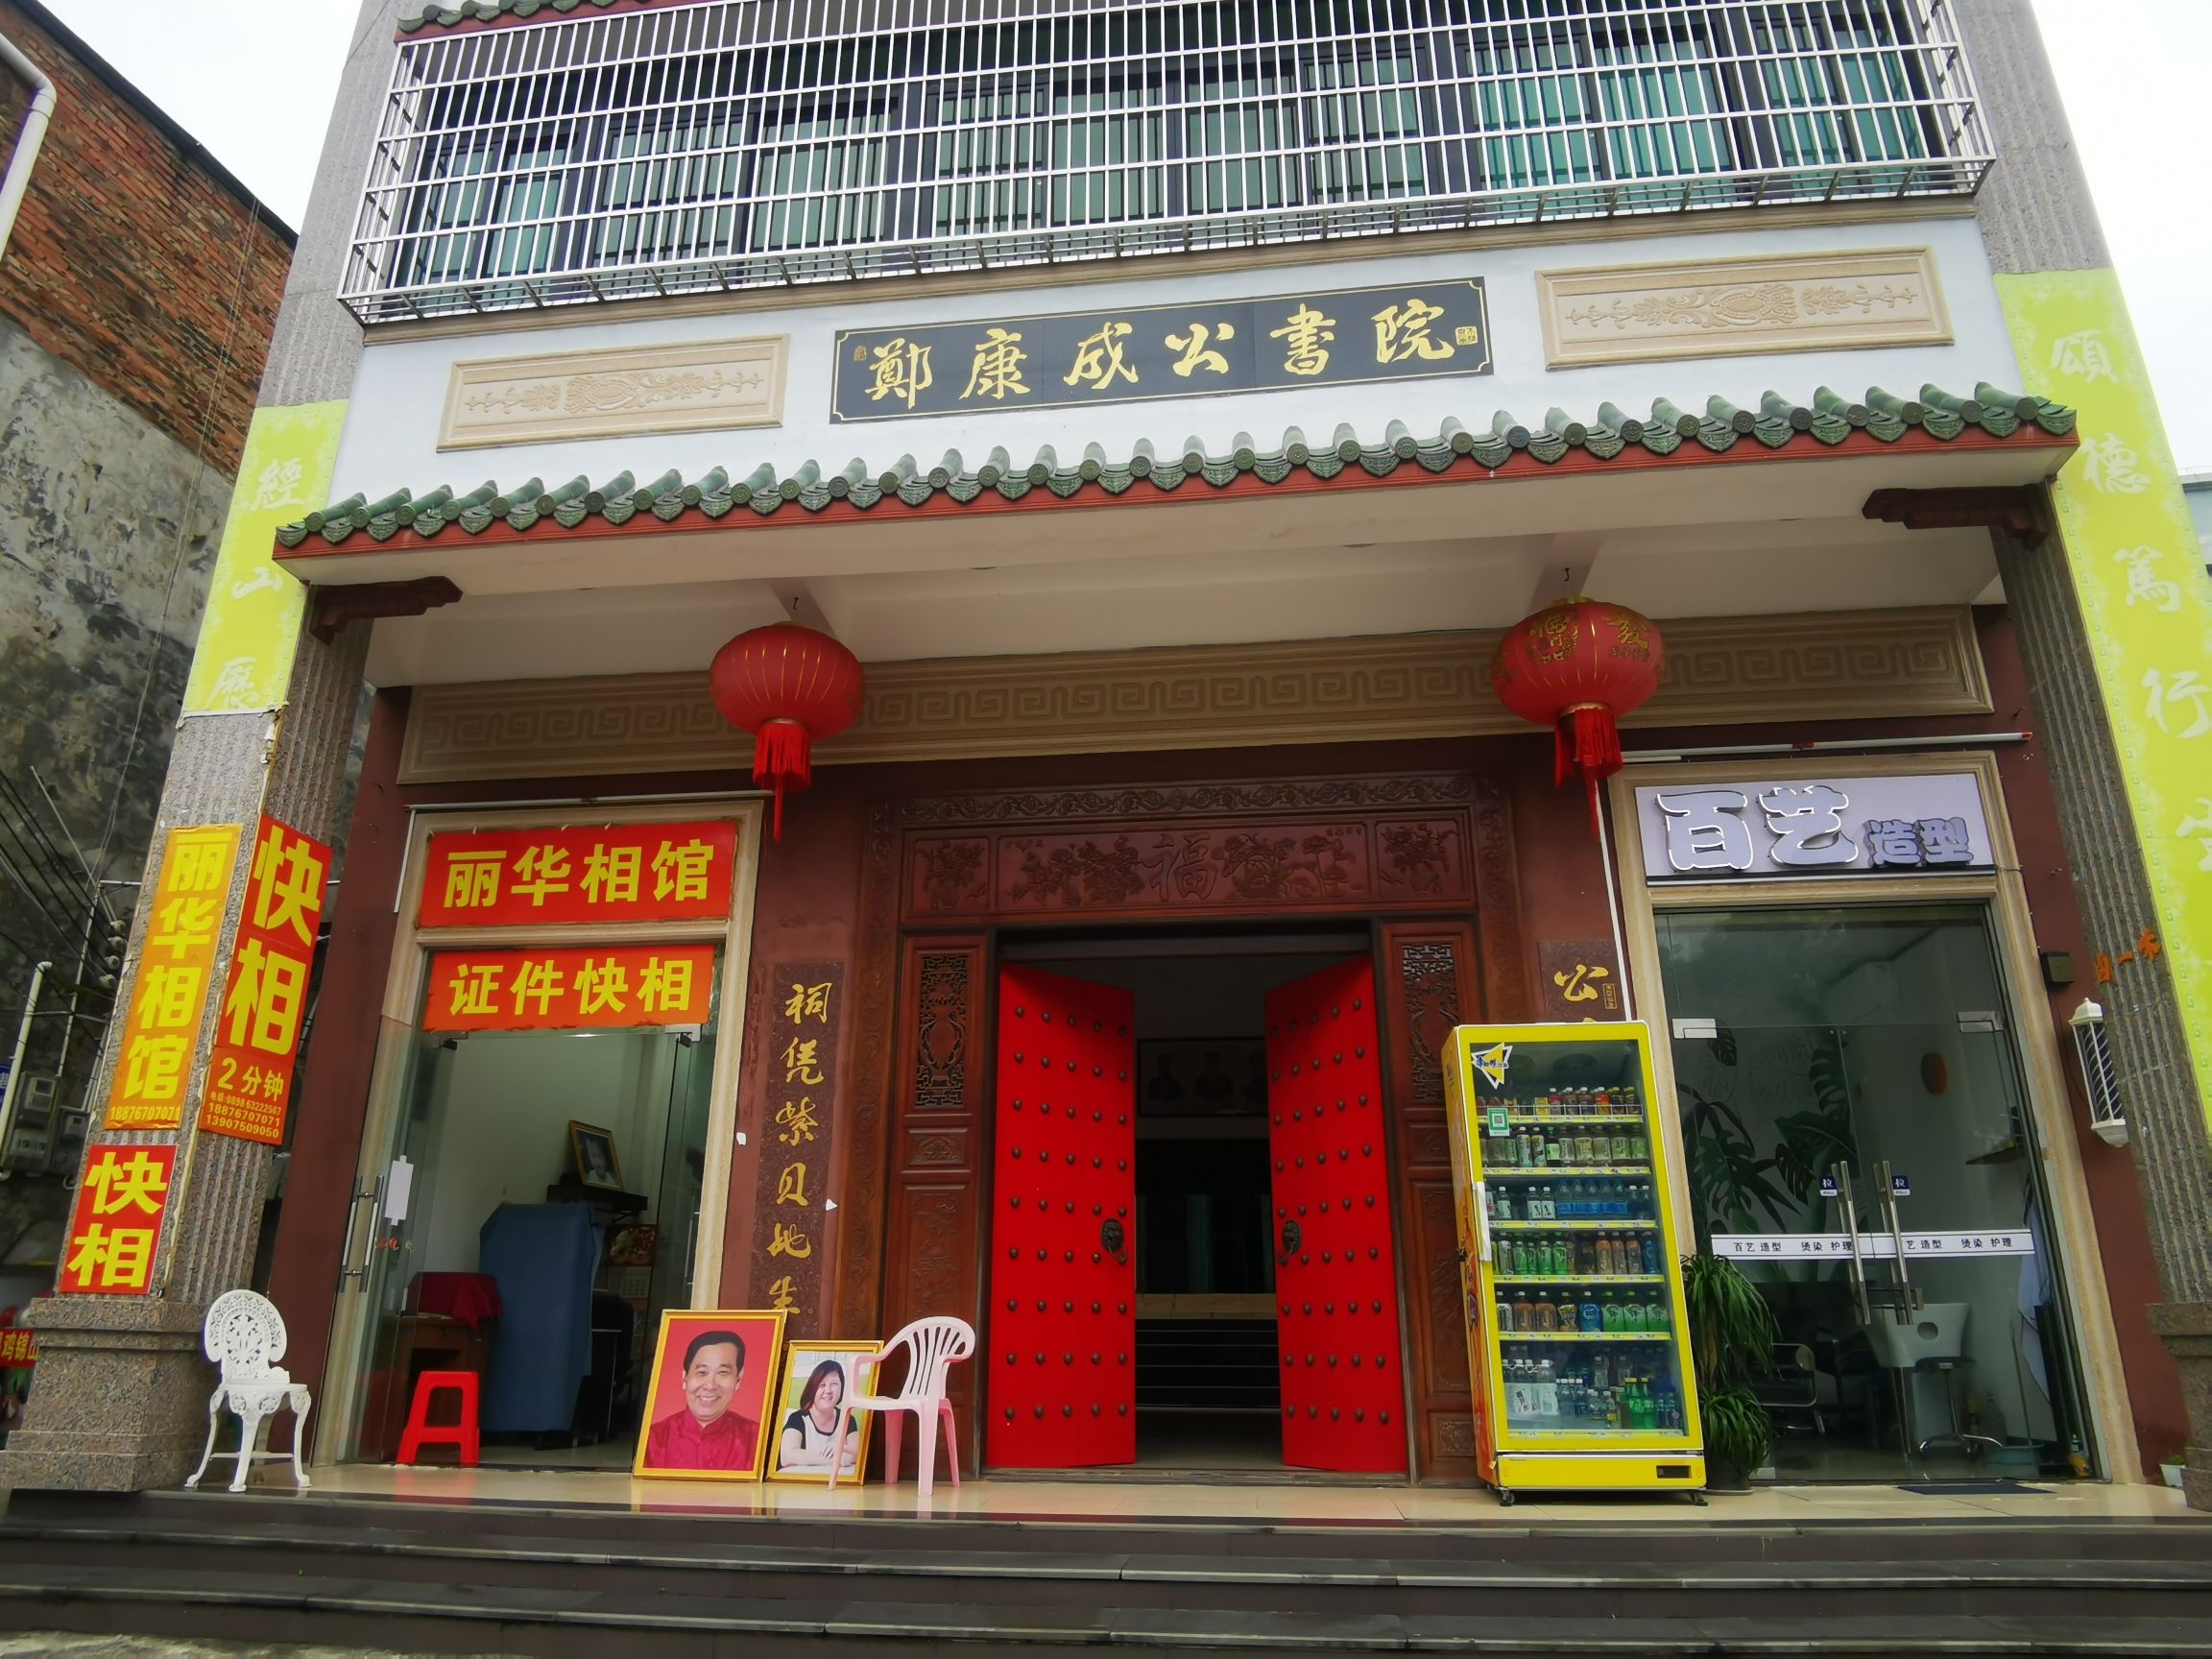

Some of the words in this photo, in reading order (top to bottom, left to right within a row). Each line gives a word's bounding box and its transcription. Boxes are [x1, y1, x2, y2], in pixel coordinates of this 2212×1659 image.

[864, 299, 1455, 410] 鄭康成公書院
[1656, 784, 1974, 870] 百艺造型
[444, 838, 714, 908] 丽华相馆
[124, 832, 232, 1099] 丽华相馆
[226, 825, 324, 1055] 快相
[448, 956, 693, 1016] 证件快相
[1553, 964, 1609, 1022] 公
[218, 1057, 284, 1102] 2分钟
[246, 1099, 282, 1116] 63222567
[110, 1105, 181, 1121] 18876707071
[206, 1114, 279, 1139] 13907509050
[208, 1102, 280, 1128] 18876707071
[67, 1151, 168, 1287] 快相
[1906, 1239, 1943, 1250] 艺造型
